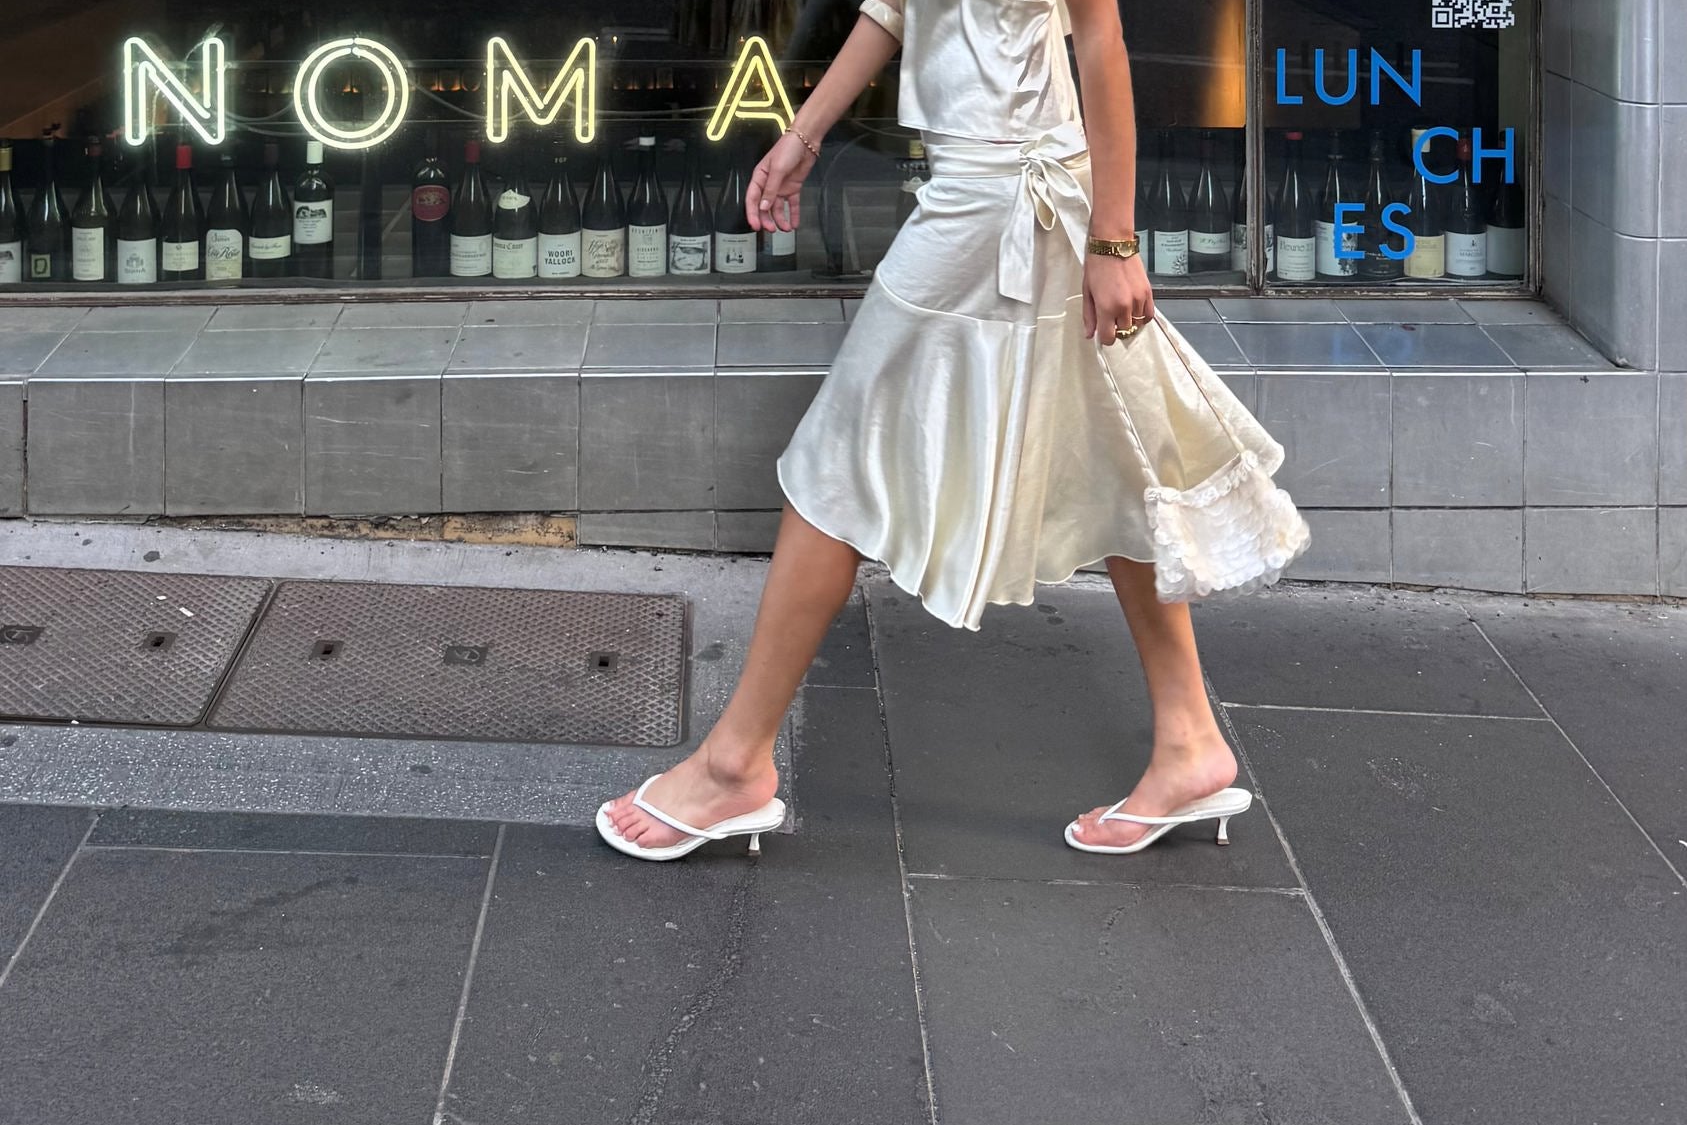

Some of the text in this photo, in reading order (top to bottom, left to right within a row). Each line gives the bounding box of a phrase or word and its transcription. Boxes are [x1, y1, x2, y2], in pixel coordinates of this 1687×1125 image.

[122, 35, 796, 150] NOMA
[1276, 47, 1421, 106] LUN
[1413, 127, 1514, 184] CH
[1333, 203, 1415, 260] ES
